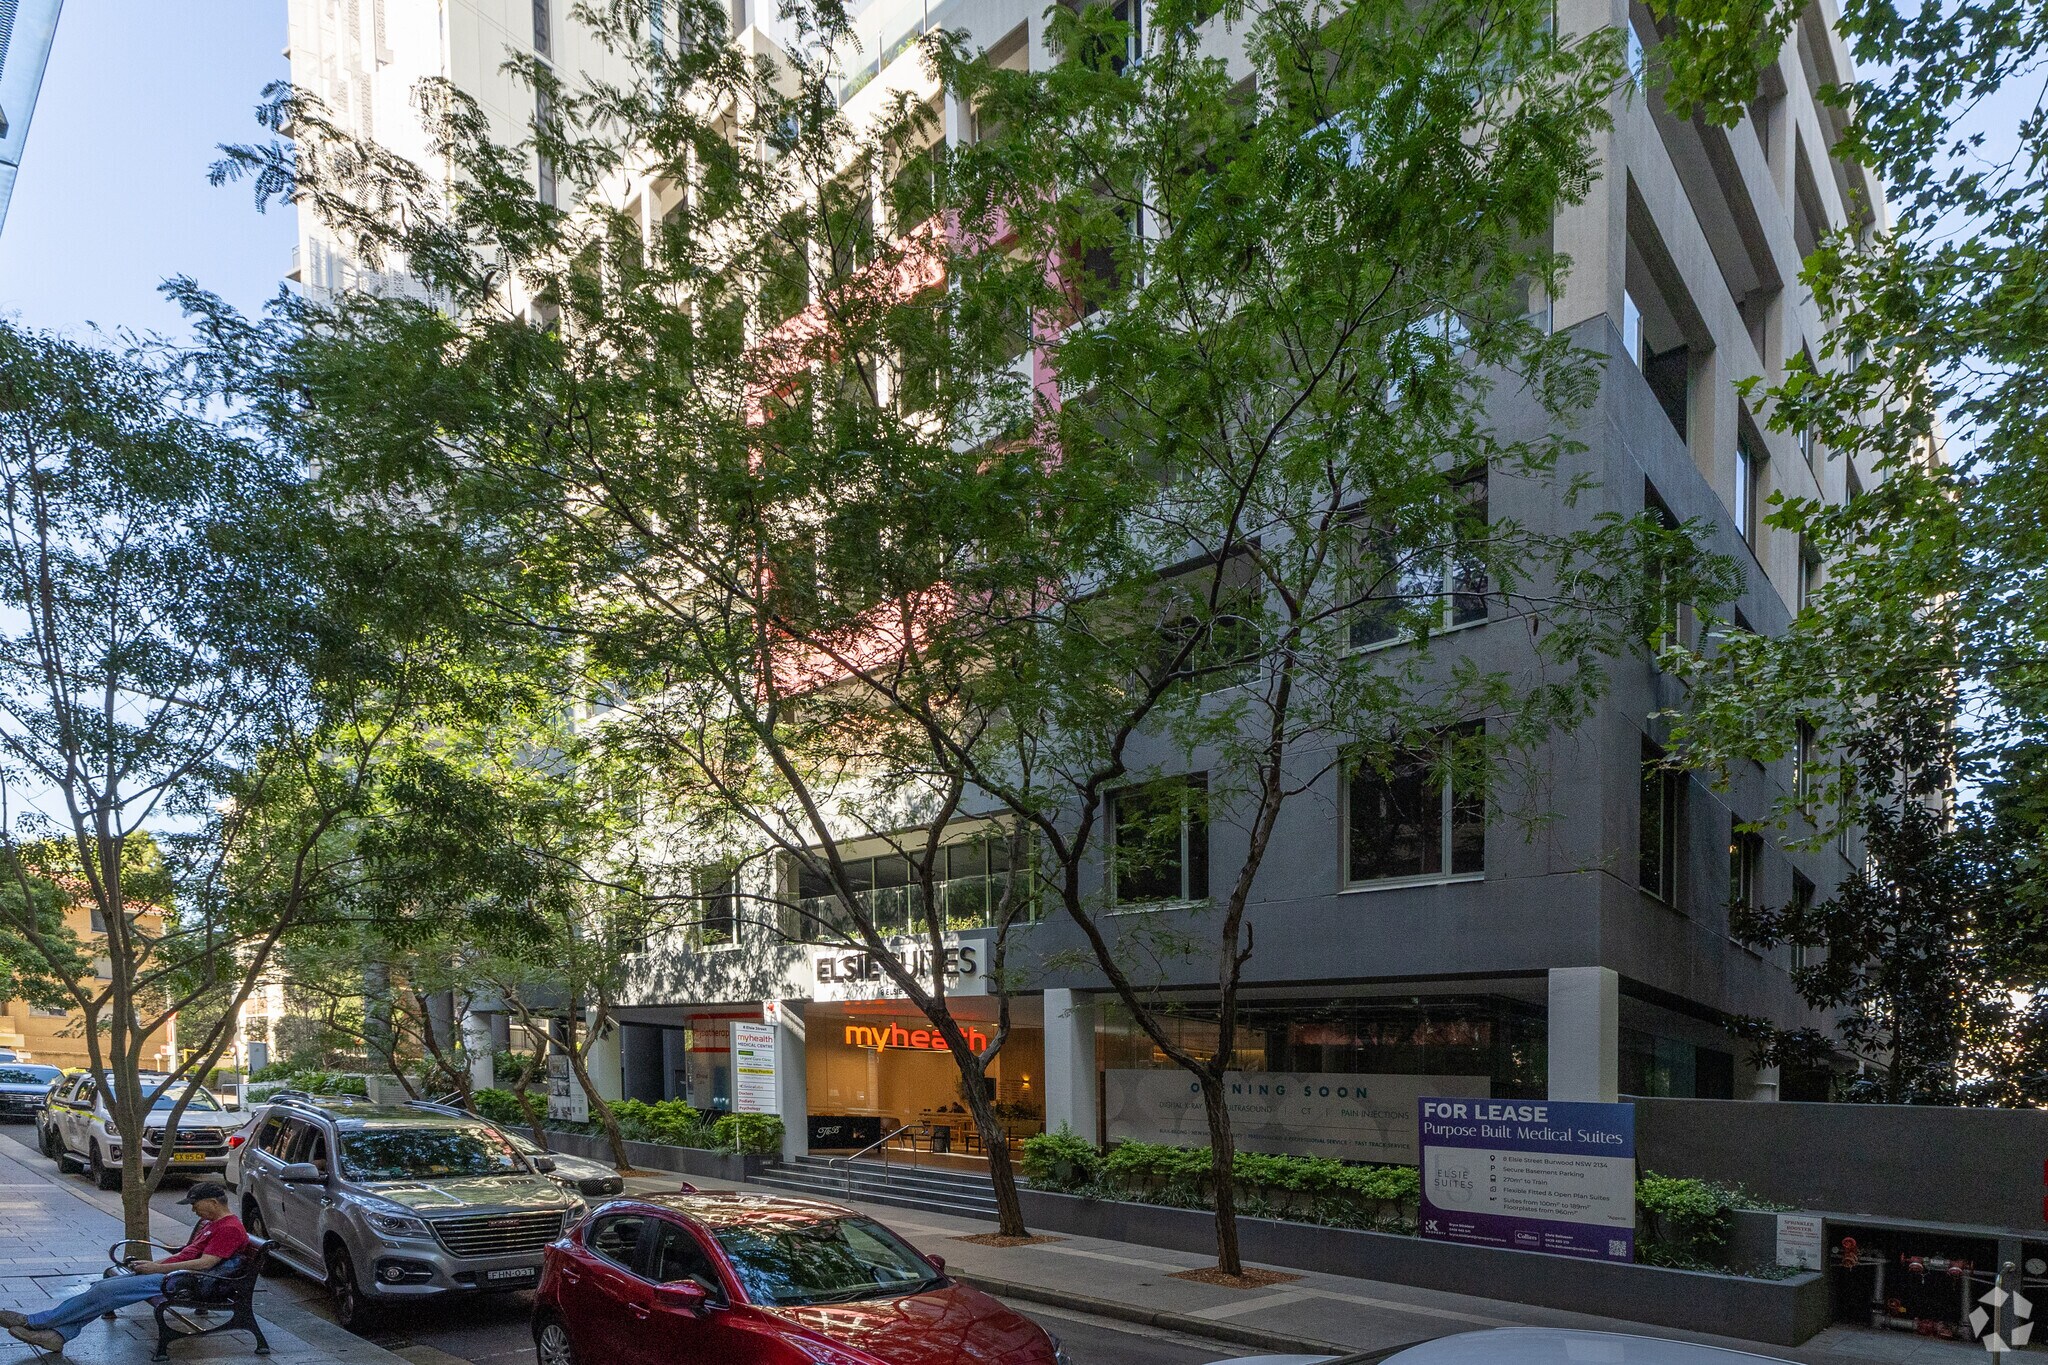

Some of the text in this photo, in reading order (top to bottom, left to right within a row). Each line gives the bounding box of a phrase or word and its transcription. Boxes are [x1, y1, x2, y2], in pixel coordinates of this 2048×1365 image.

[817, 946, 977, 984] ELSIE UIES
[738, 1034, 773, 1043] myhealth
[845, 1022, 987, 1053] myheah
[1190, 1082, 1368, 1099] ONING SOON
[1159, 1101, 1182, 1109] DIGITAL
[1226, 1104, 1273, 1114] ULTRASOUND
[1301, 1107, 1312, 1115] CT
[1341, 1108, 1410, 1120] PAIN INJECTIONS
[1424, 1102, 1549, 1123] FOR LEASE
[1424, 1122, 1624, 1145] Purpose Built Medical Suites
[1326, 1138, 1348, 1146] SERVICE
[1369, 1141, 1386, 1149] TRACK
[1387, 1142, 1410, 1150] SERVICE
[1544, 1158, 1574, 1167] Burwood
[1437, 1169, 1469, 1180] ELSIE
[1502, 1166, 1525, 1174] Secure
[1525, 1168, 1558, 1176] Basement
[1559, 1170, 1585, 1179] Parking
[1433, 1178, 1474, 1189] SUITES
[1503, 1187, 1527, 1195] Flexible
[1528, 1189, 1547, 1197] Fitted
[1553, 1191, 1572, 1200] Open
[1589, 1194, 1610, 1202] Suites
[1503, 1196, 1523, 1204] Suites
[1503, 1204, 1538, 1213] Floorplates
[1516, 1232, 1538, 1241] Colliers
